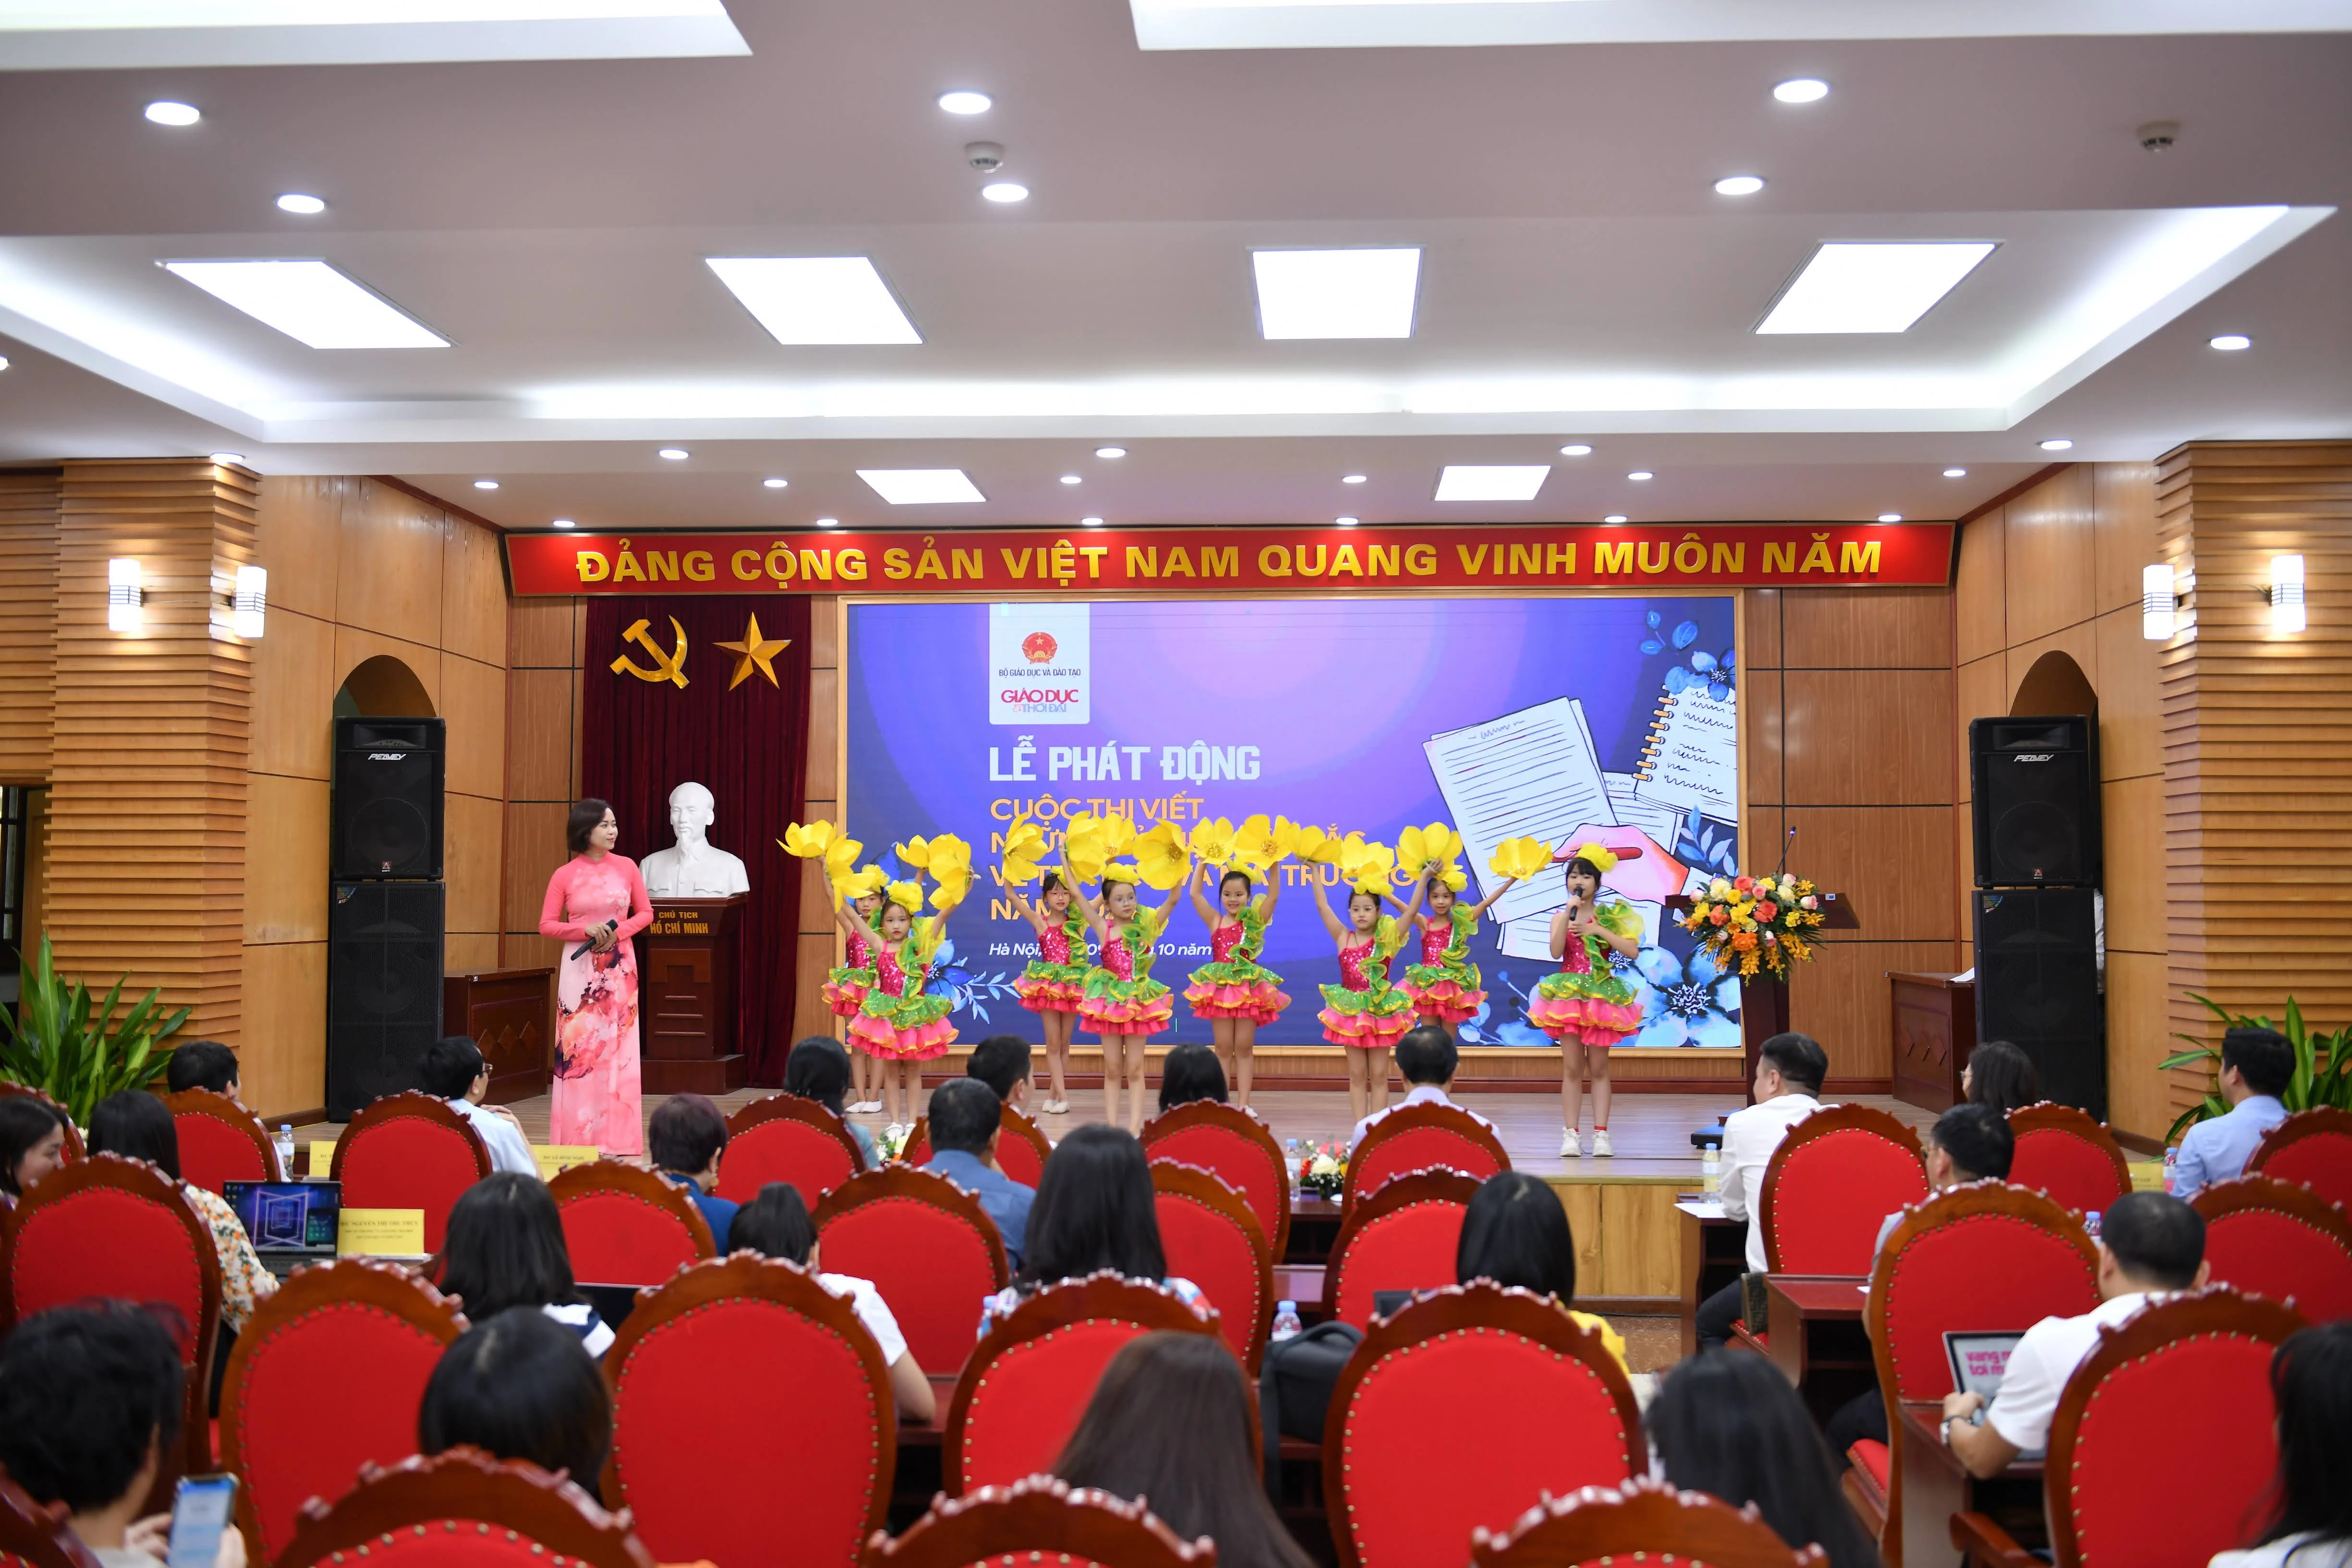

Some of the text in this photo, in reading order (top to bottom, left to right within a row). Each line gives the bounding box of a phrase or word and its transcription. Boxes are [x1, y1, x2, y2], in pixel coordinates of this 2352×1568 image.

[576, 533, 1882, 589] ĐẢNG CỘNG SẢN VIỆT NAM QUANG VINH MUÔN NĂM
[999, 667, 1081, 678] BỘ GIÁO DỤC VÀ ĐÀO TẠO
[1001, 687, 1079, 705] GIÁO DỤC
[989, 735, 1261, 786] LỄ PHÁT ĐỘNG
[990, 790, 1205, 826] CUỘC THI VIẾT
[658, 910, 676, 919] CHỦ
[650, 920, 709, 934] HỒ CHÍ MINH
[989, 943, 1010, 956] Hà
[1158, 944, 1175, 956] 10
[1177, 943, 1212, 956] năm
